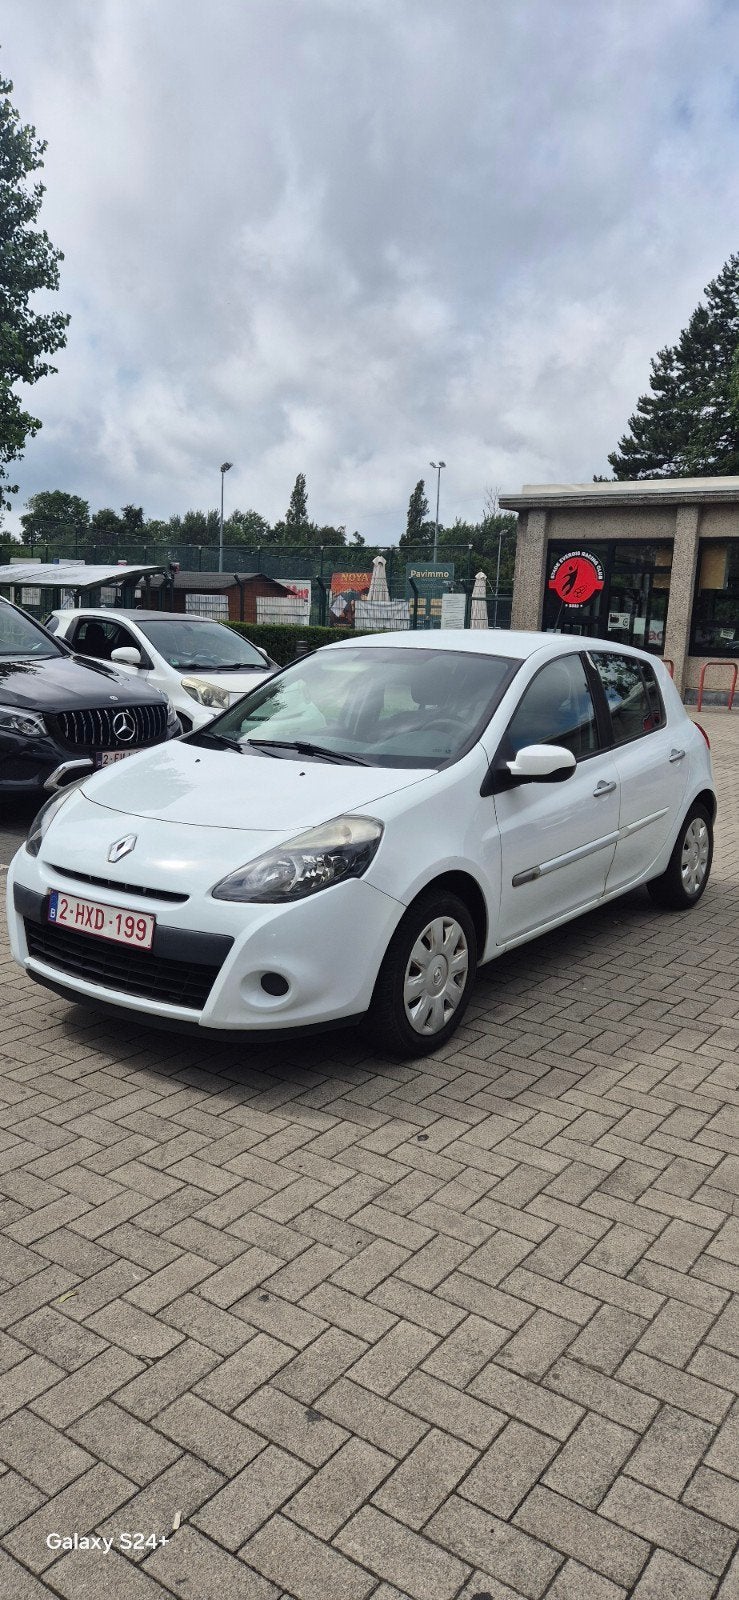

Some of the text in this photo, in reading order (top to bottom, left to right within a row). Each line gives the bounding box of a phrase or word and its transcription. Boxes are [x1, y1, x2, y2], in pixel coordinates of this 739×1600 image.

[341, 573, 369, 582] NOYA
[410, 569, 450, 579] Pavimmo
[550, 562, 561, 579] STADE
[596, 564, 604, 580] CLUB
[50, 898, 147, 941] B 2-HXD-199
